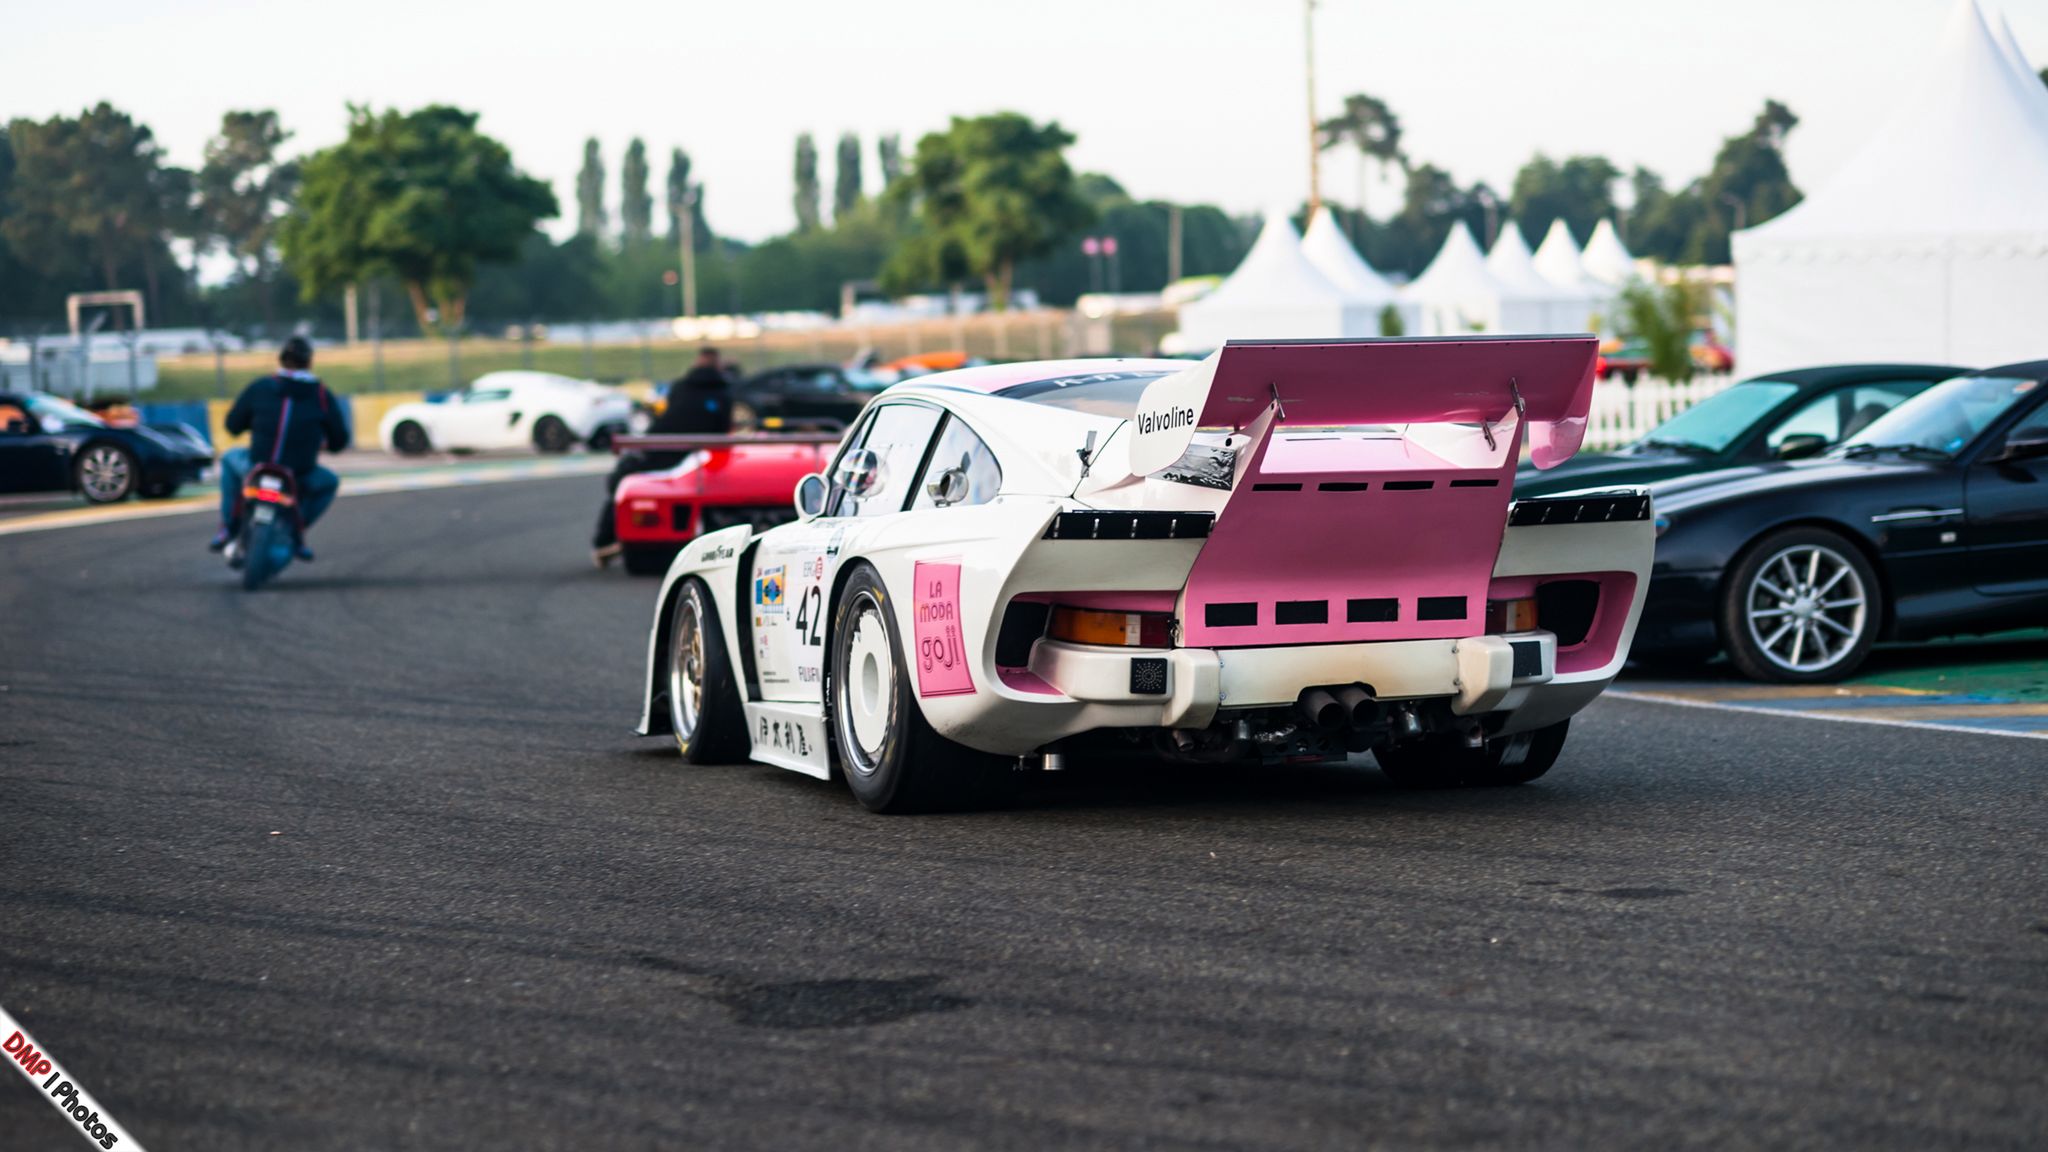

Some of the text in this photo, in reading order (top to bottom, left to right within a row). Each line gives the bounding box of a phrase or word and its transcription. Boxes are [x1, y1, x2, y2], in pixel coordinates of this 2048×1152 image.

[1138, 406, 1194, 435] Valvoline
[929, 581, 942, 598] LA
[796, 585, 821, 646] 42
[920, 602, 954, 622] MODA
[921, 625, 960, 673] goji
